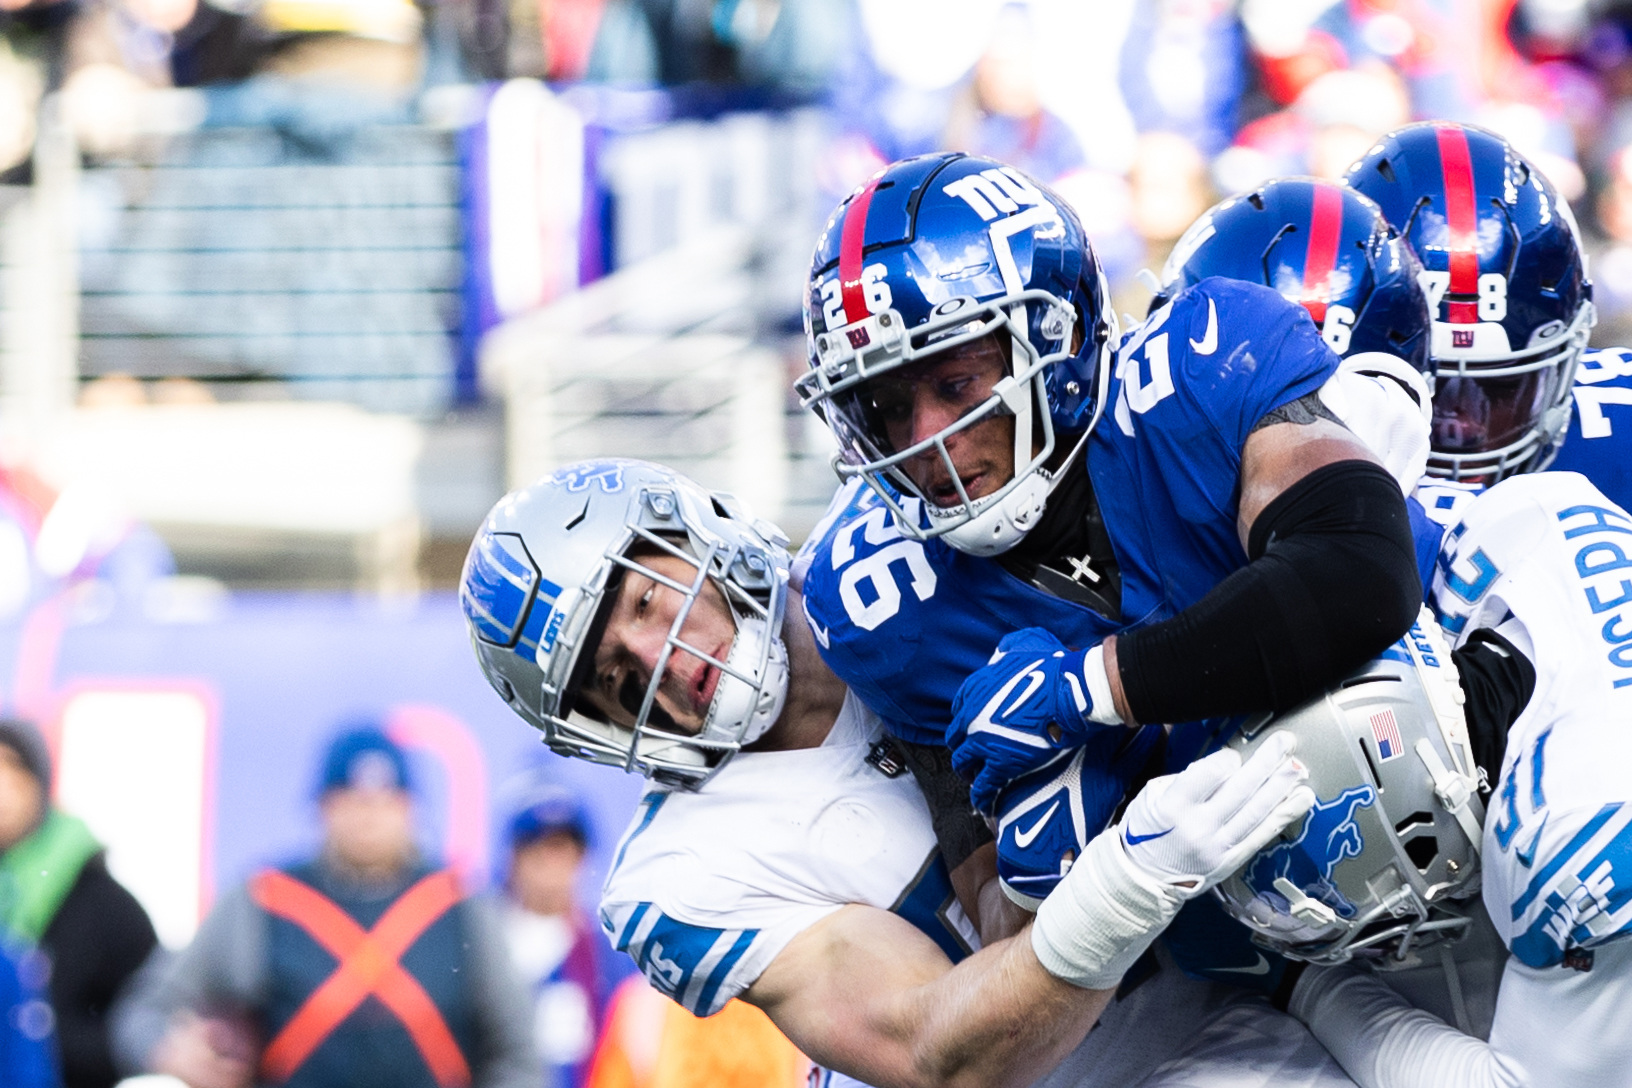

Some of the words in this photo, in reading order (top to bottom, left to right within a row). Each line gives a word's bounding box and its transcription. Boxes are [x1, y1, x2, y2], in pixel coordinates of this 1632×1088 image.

[821, 262, 893, 332] 26
[1416, 269, 1508, 322] 78
[831, 494, 938, 632] 26
